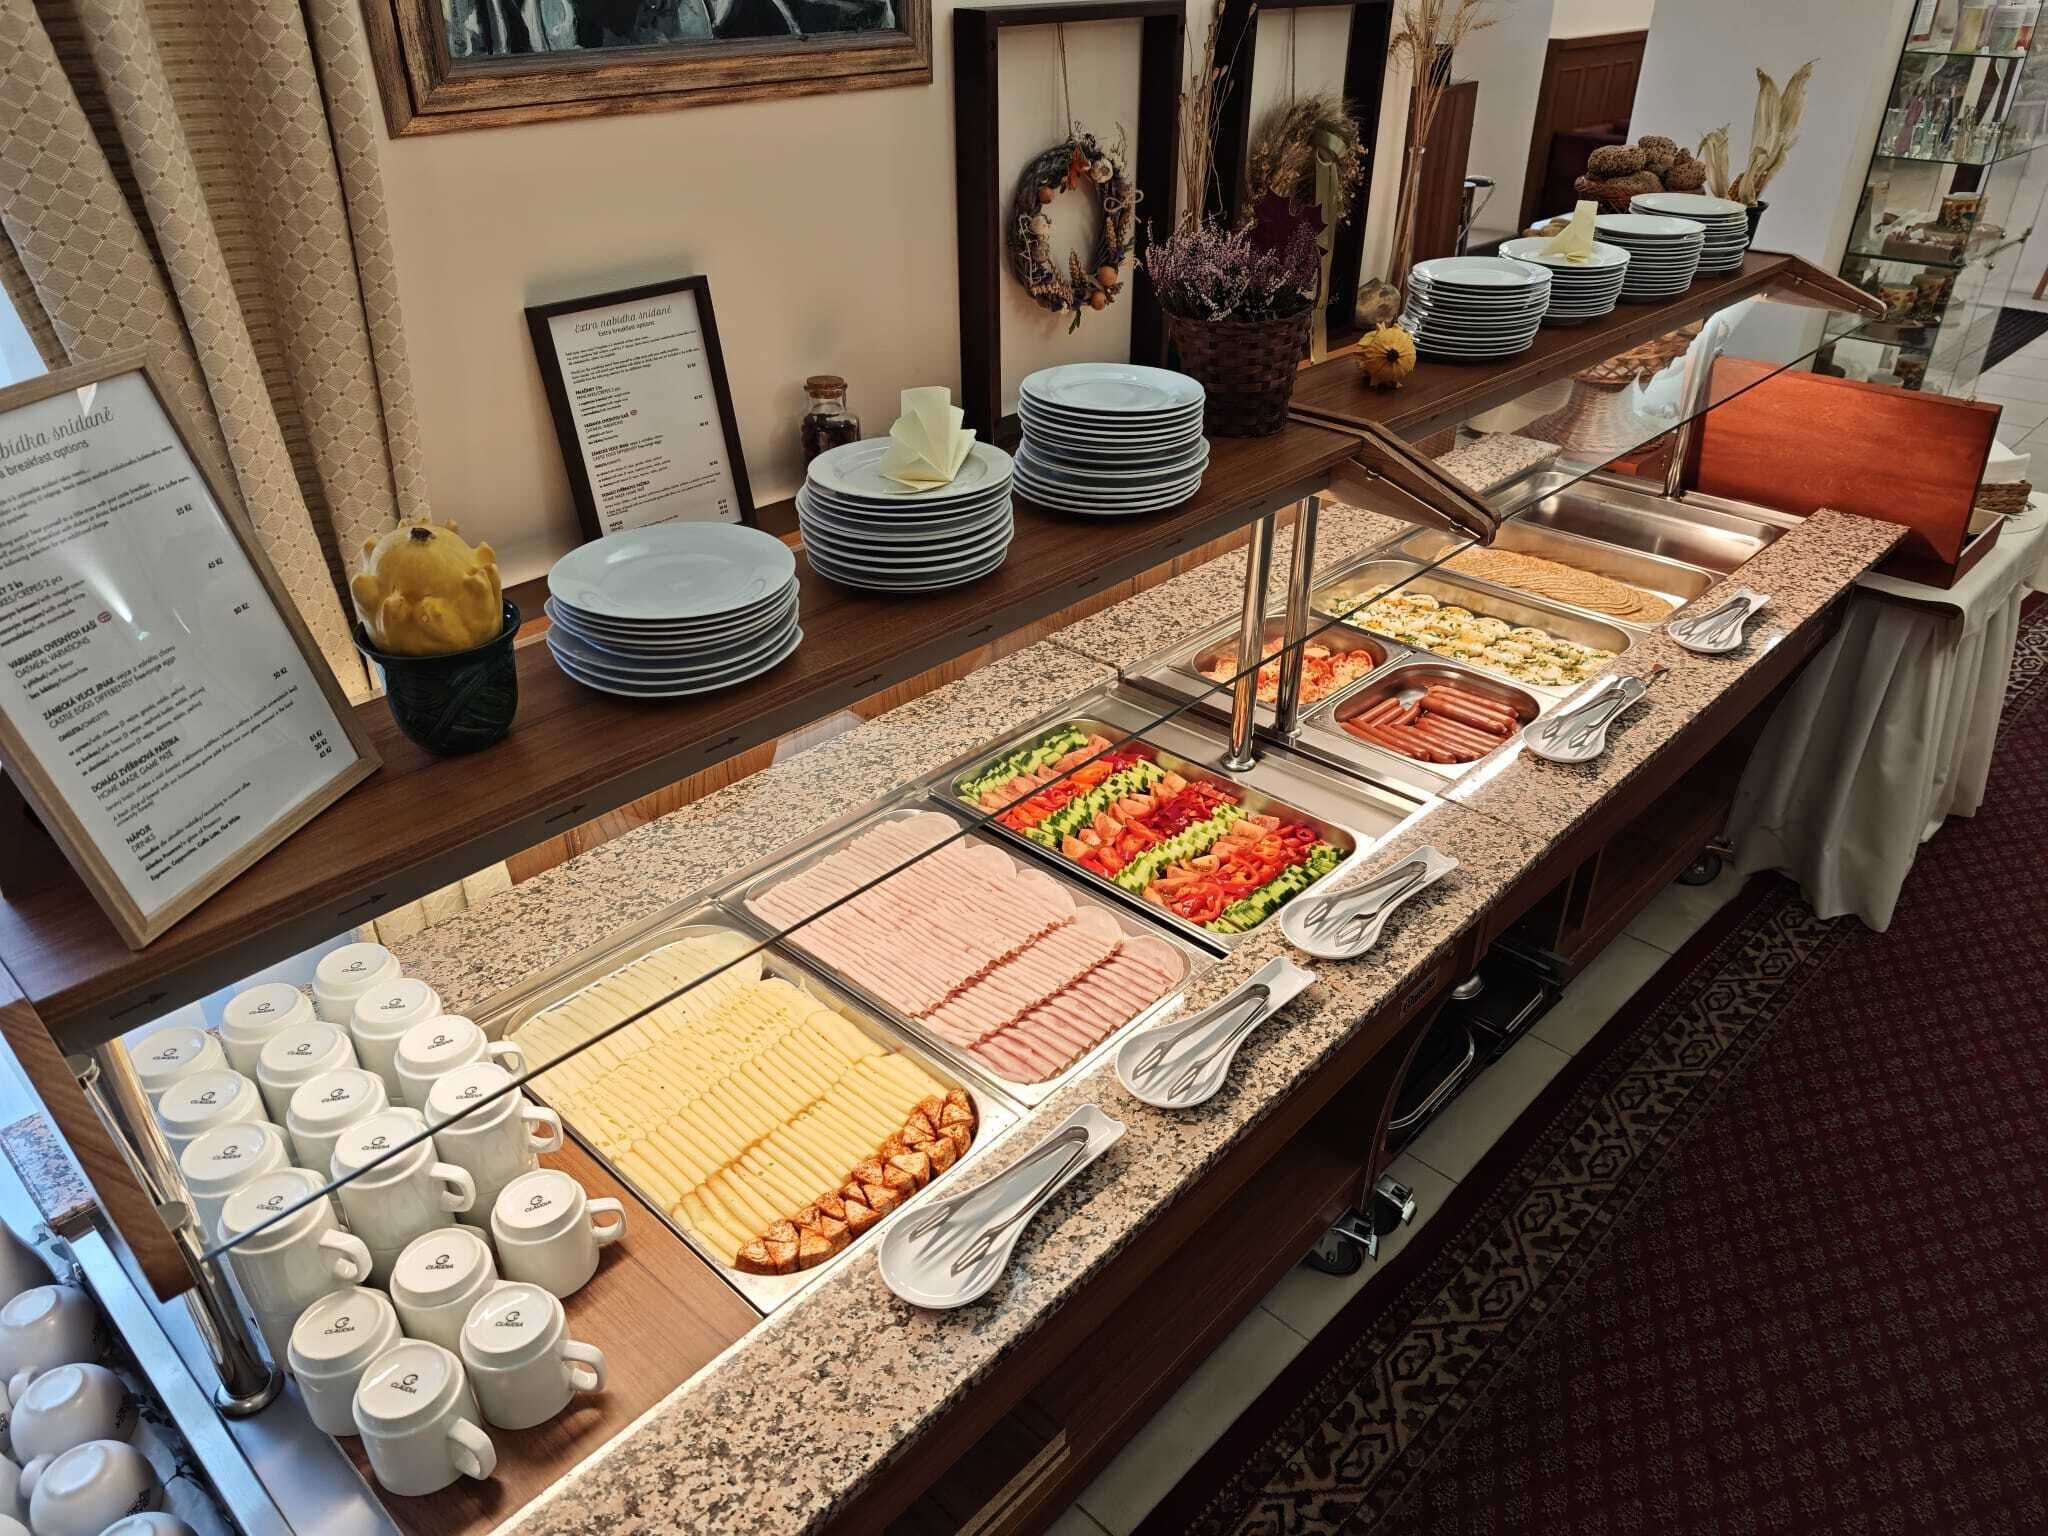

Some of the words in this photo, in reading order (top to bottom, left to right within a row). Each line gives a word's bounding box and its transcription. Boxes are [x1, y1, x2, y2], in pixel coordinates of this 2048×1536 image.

[6, 452, 52, 475] breakfast
[54, 439, 90, 460] options
[524, 1200, 552, 1213] CLAUDIA
[425, 1263, 454, 1271] CLAUDIA
[495, 1320, 524, 1328] CLAUDIA
[324, 1326, 356, 1335] CLAUDIA
[390, 1381, 417, 1395] CLAUDIA
